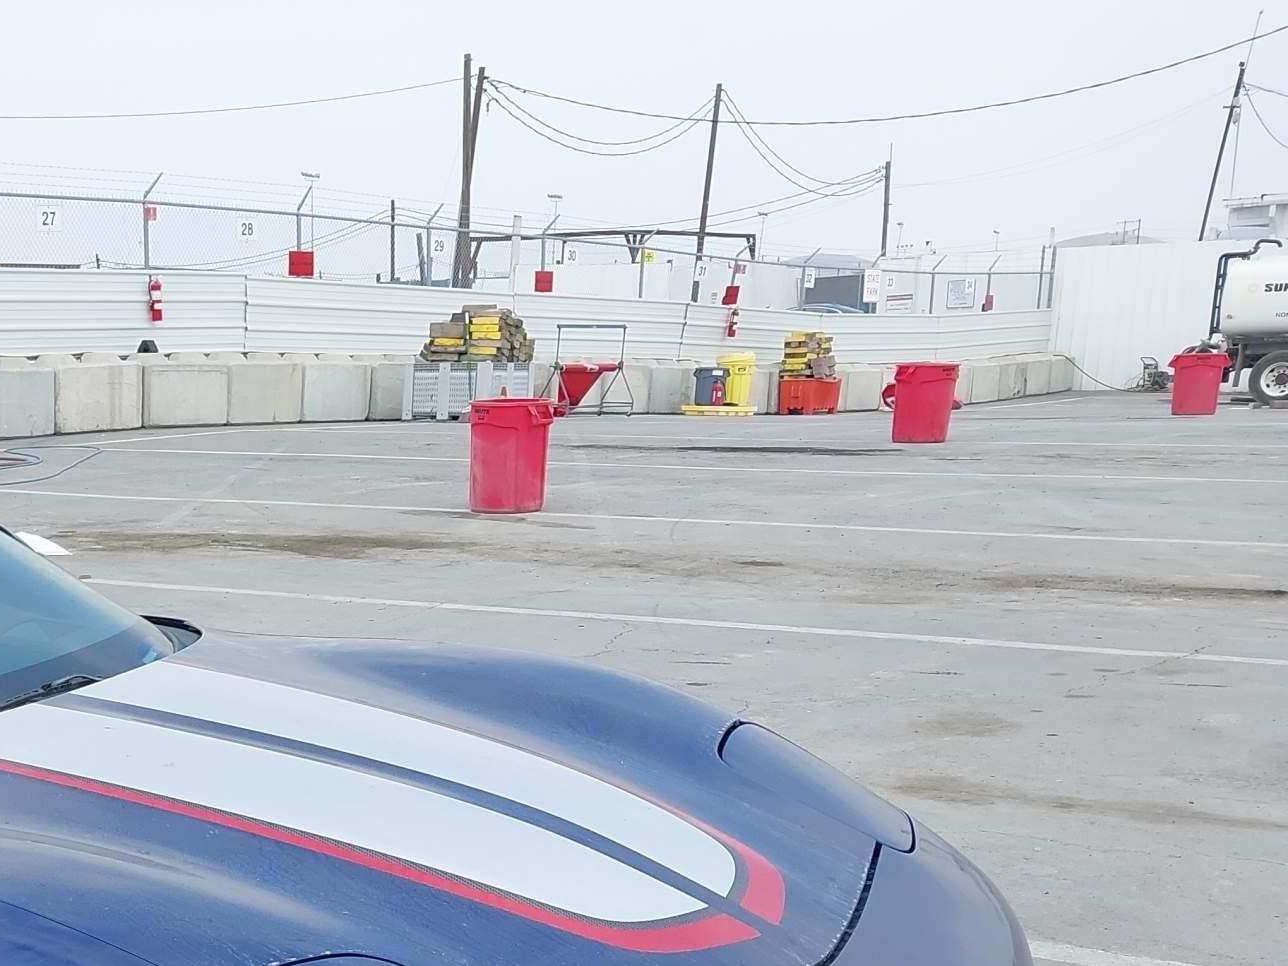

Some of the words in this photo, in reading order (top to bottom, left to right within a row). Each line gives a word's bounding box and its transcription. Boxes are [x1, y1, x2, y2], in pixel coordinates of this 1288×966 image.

[41, 211, 57, 226] 27
[241, 222, 254, 236] 28
[434, 239, 445, 252] 29
[567, 249, 577, 262] 30
[698, 266, 707, 277] 31
